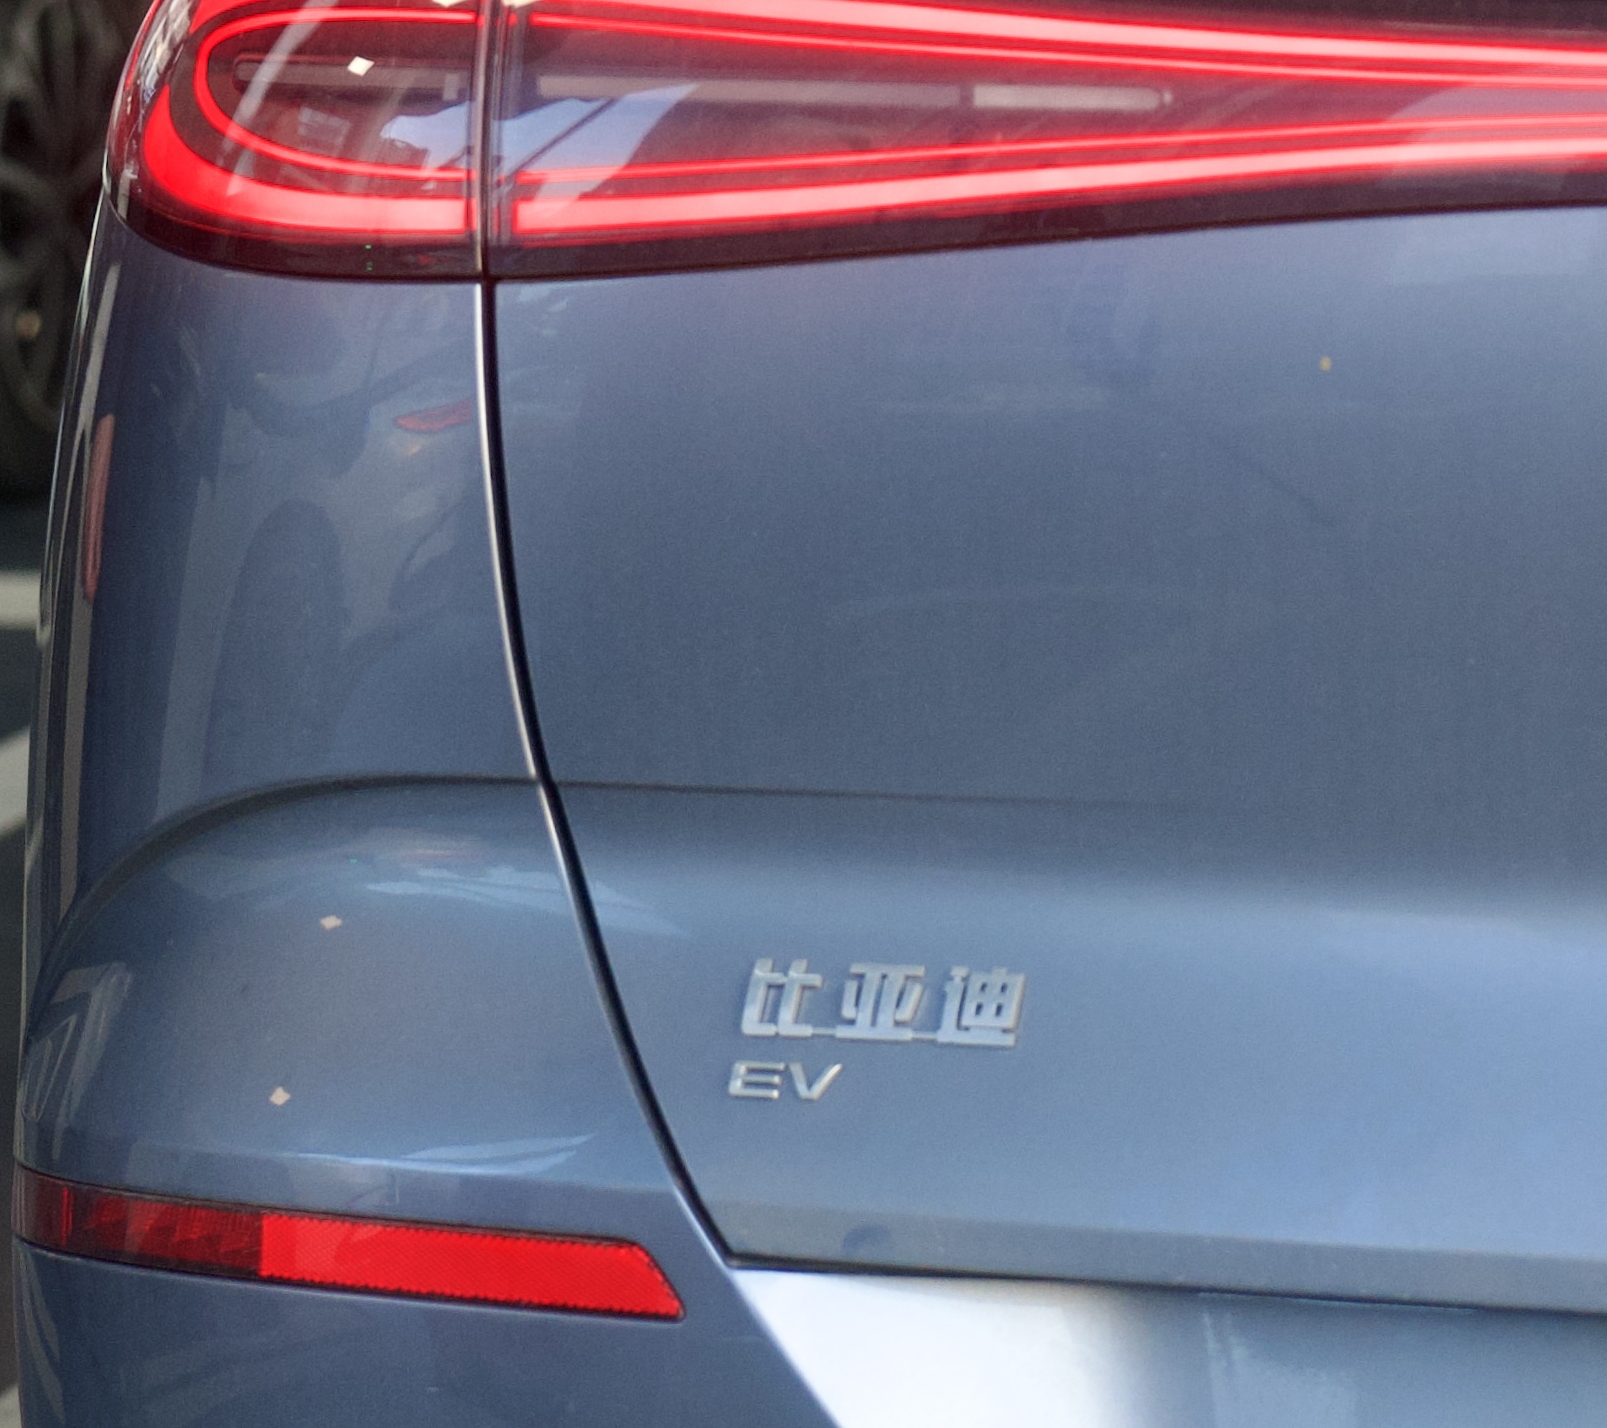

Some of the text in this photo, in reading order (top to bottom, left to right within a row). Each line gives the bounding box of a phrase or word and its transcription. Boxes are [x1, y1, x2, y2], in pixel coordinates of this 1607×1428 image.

[741, 957, 1027, 1047] 比亚迪
[727, 1061, 843, 1101] EV
